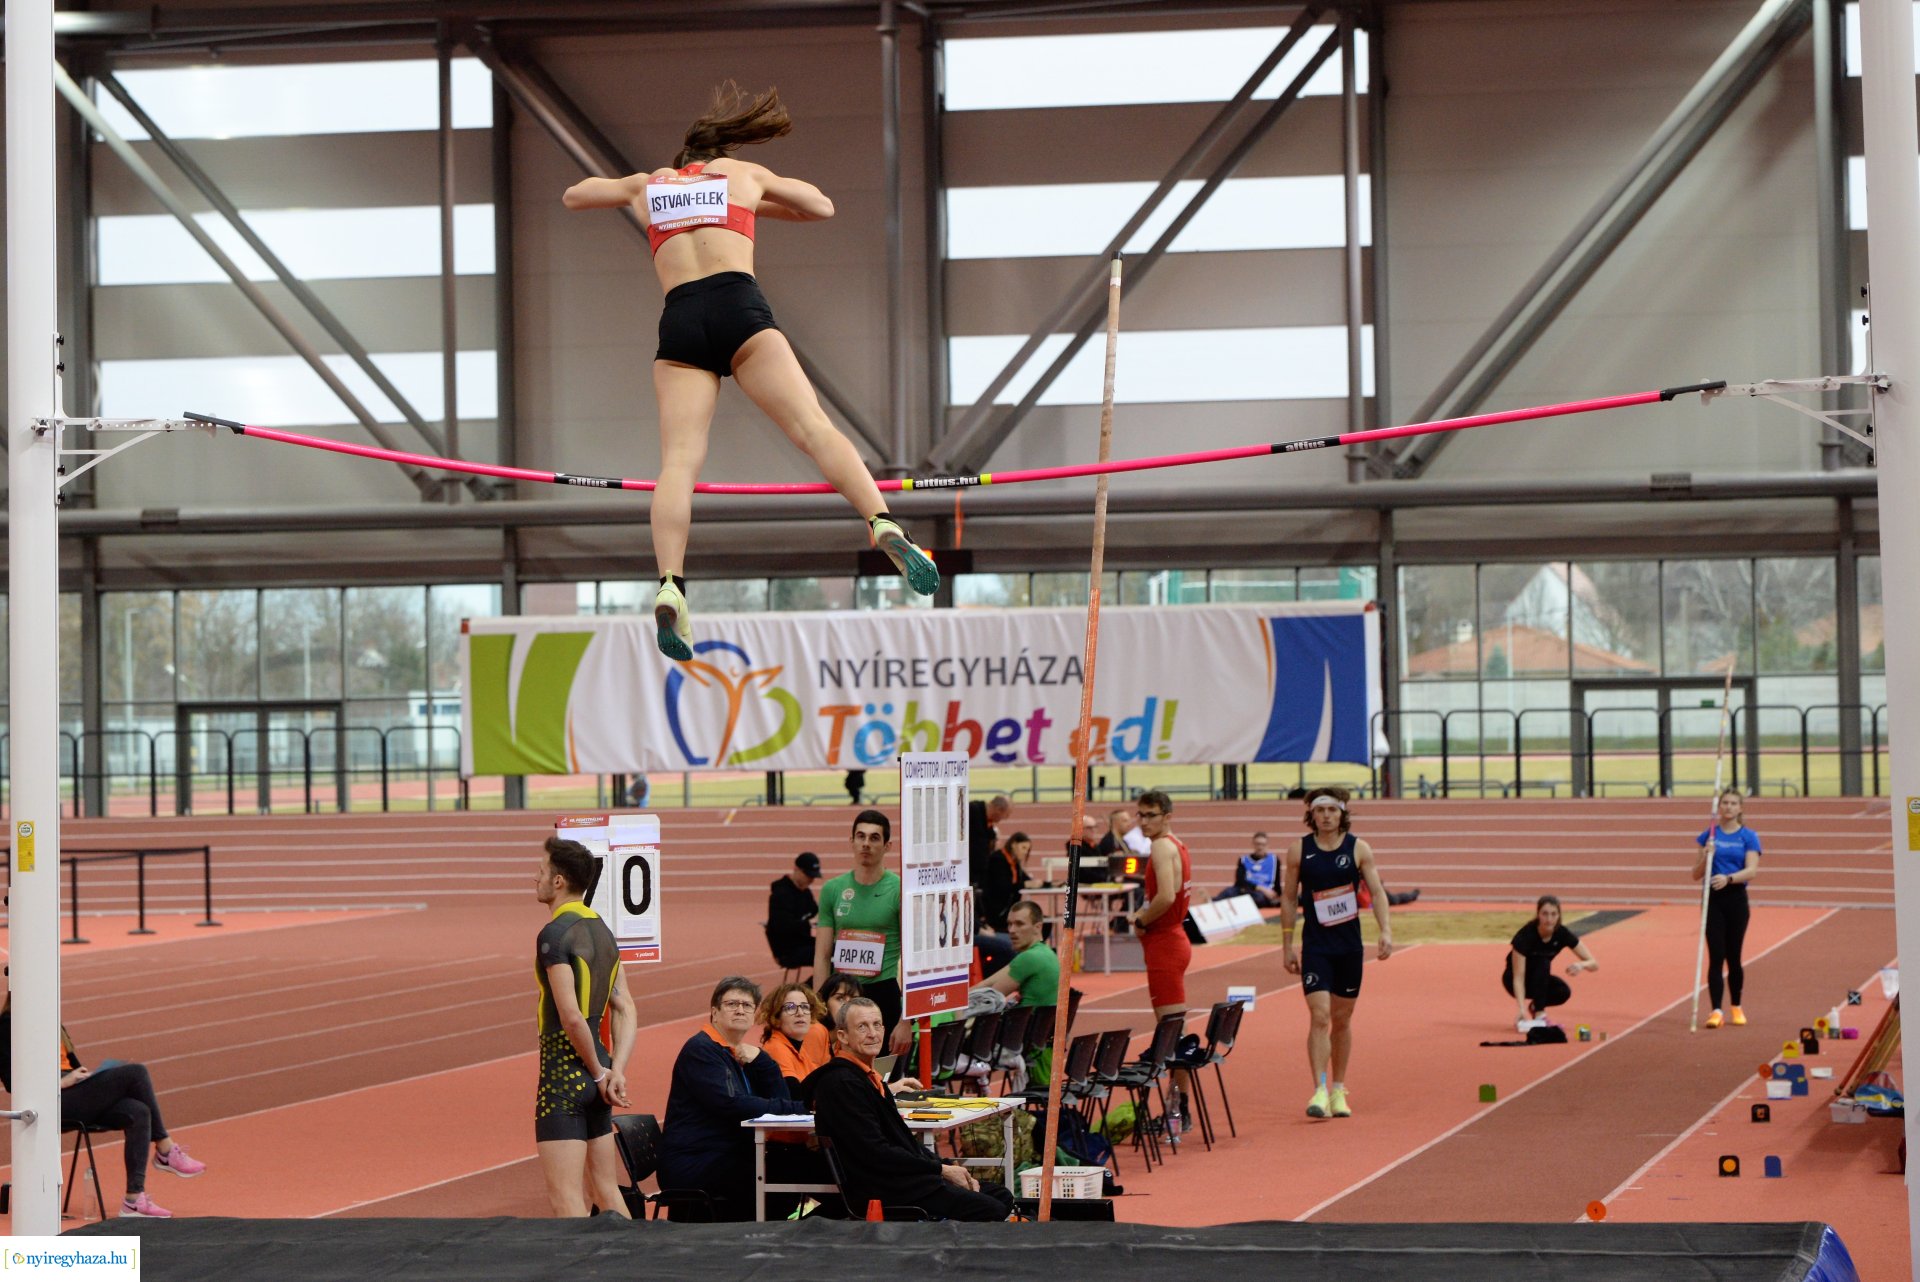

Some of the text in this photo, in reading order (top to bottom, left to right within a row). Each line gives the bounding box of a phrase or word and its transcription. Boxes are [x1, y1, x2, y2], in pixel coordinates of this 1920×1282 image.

[651, 191, 724, 213] ISTVÁN-ELEK
[1285, 440, 1326, 452] altius
[568, 477, 608, 487] altius
[915, 476, 978, 488] altius.hu
[818, 650, 1085, 688] NYÍREGYHÁZA
[818, 696, 1178, 766] Többet ad!
[905, 761, 939, 778] COMPETITOR
[944, 760, 968, 777] ATTEMPT
[1125, 857, 1137, 874] 3
[918, 866, 957, 888] PERFORMANCE
[1327, 902, 1348, 917] IVÁN
[839, 948, 876, 965] PAP KR.
